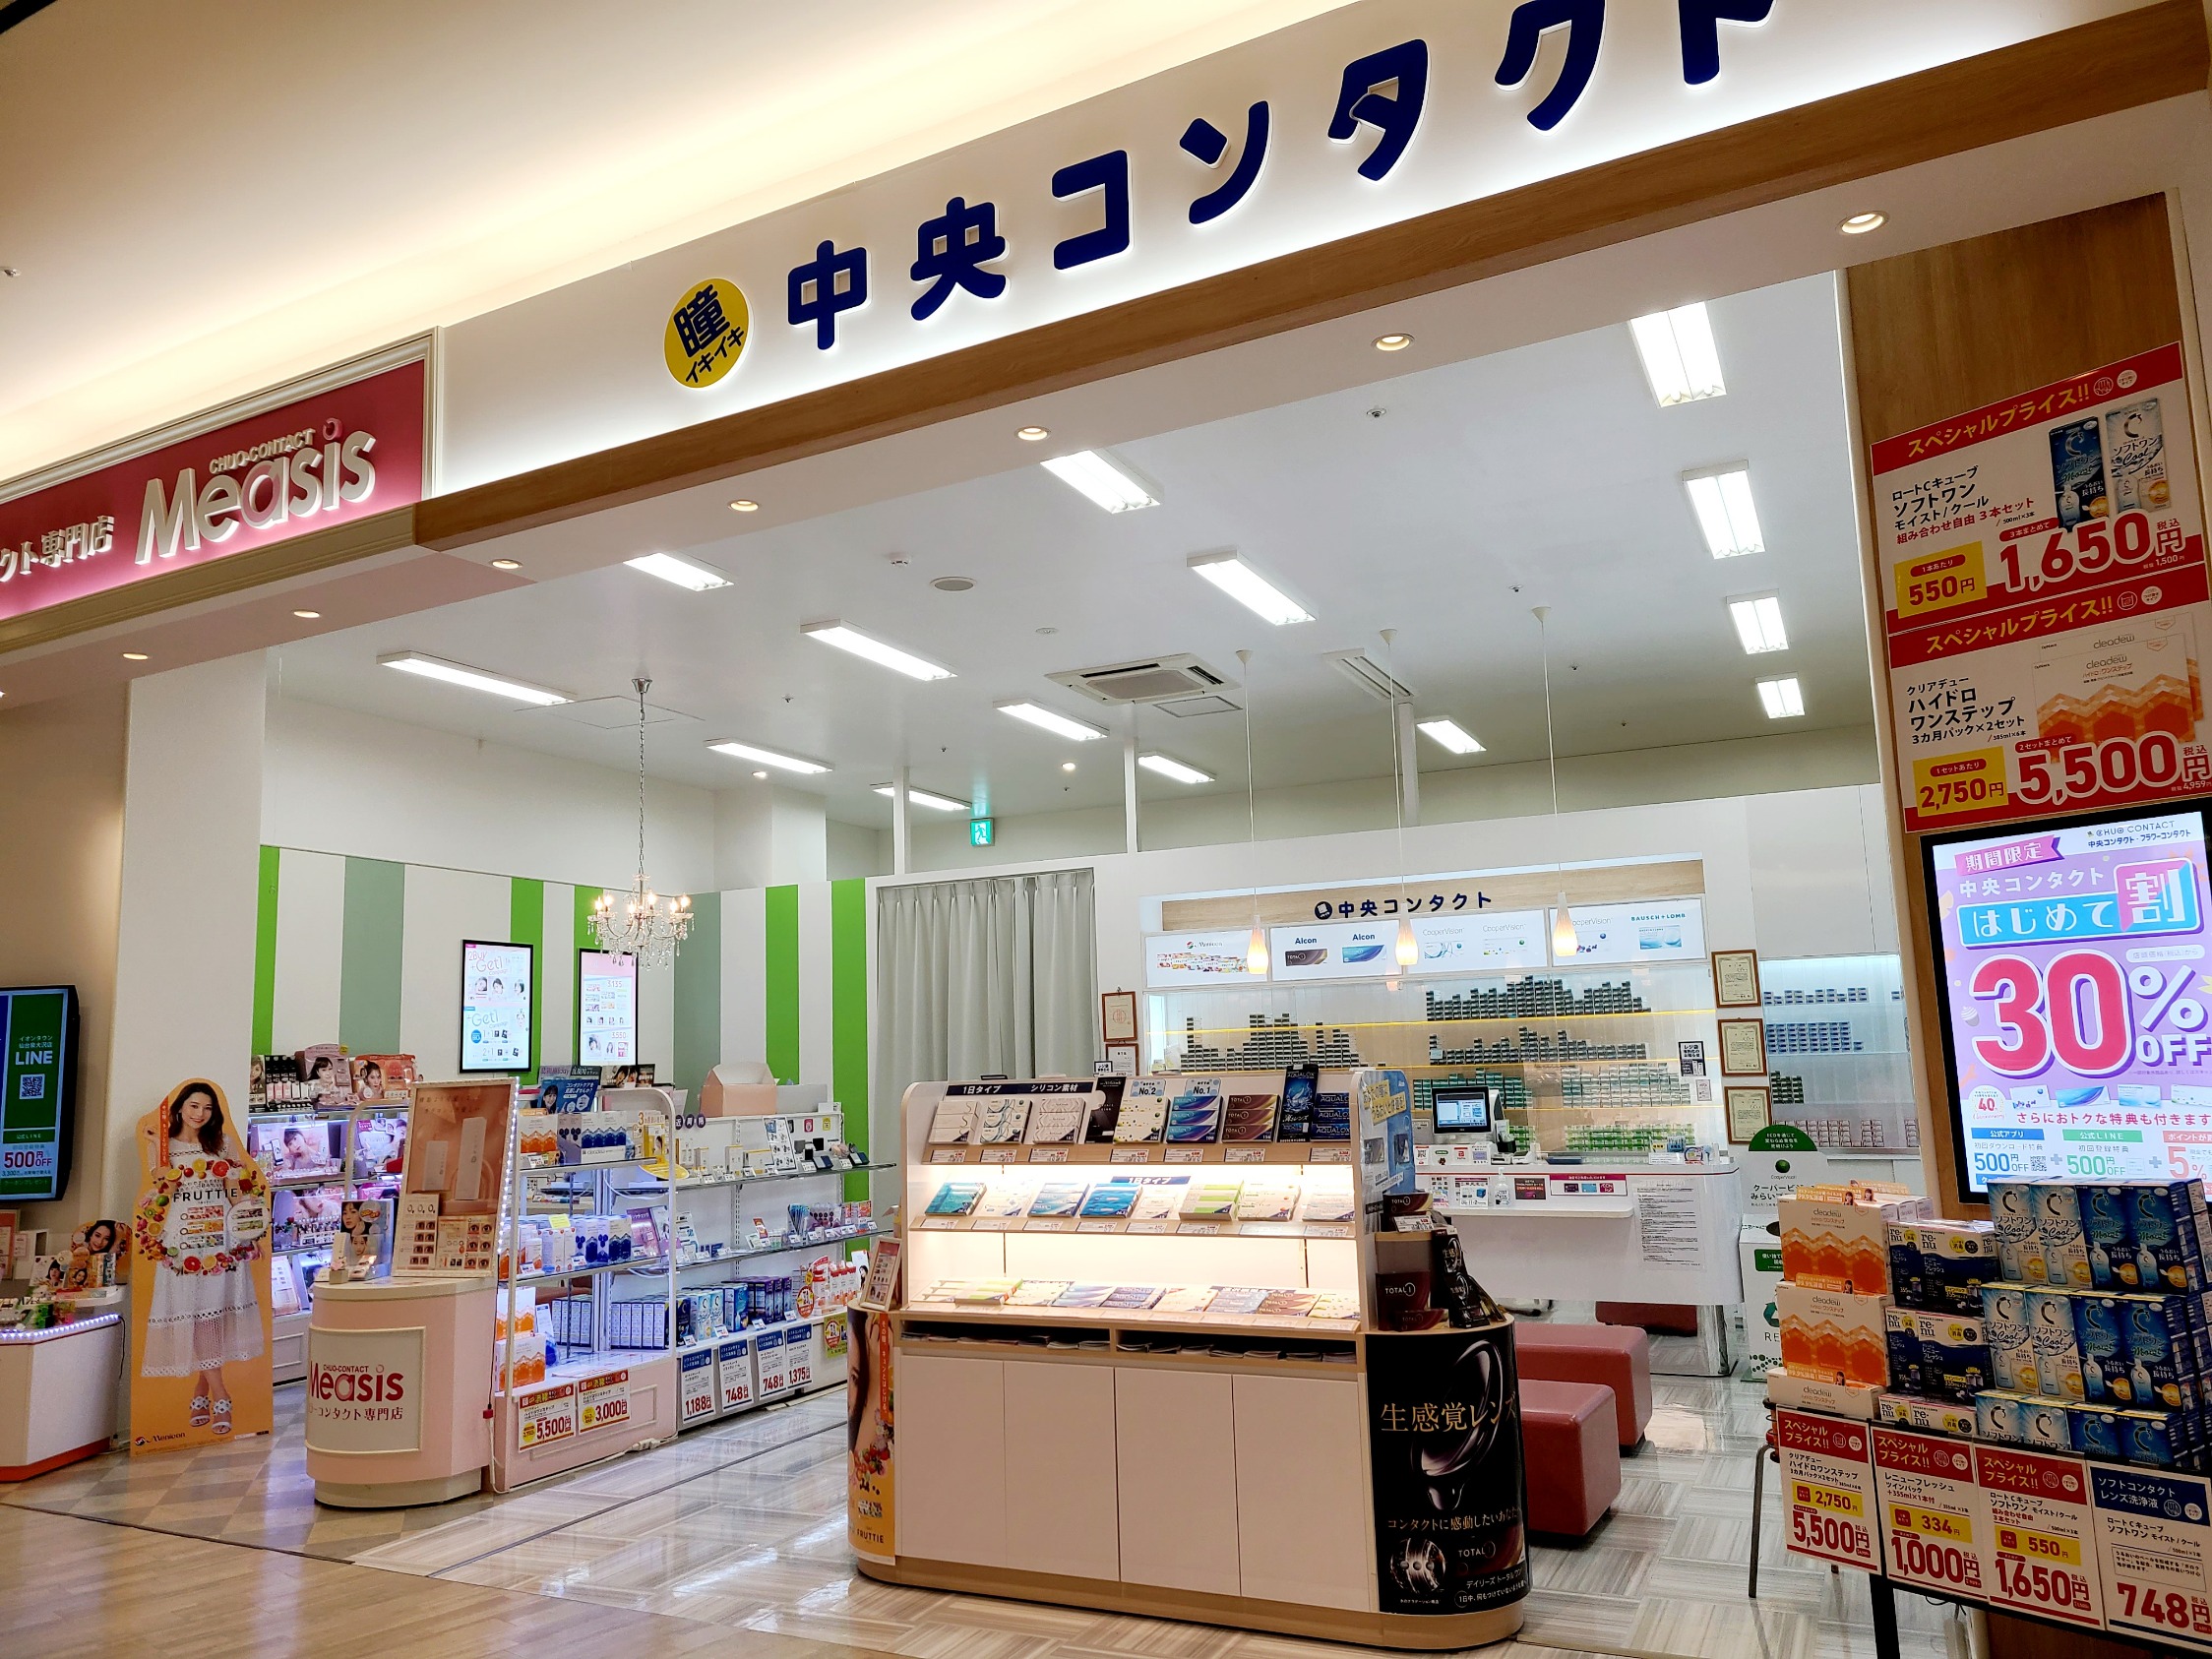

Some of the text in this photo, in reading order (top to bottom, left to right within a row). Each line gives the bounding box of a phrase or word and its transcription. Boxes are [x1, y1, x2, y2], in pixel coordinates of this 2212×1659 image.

[787, 0, 1771, 350] 中央コンタクト
[673, 283, 730, 358] 瞳
[685, 326, 745, 383] イキイキ
[135, 417, 377, 566] Measis
[1893, 483, 1976, 519] ソフトワン
[2093, 634, 2135, 649] cleadew
[2086, 654, 2127, 670] cleadew
[1906, 676, 1970, 697] クリアデュー
[1907, 687, 1977, 714] ハイドロ
[1909, 696, 2016, 733] ワンステップ
[2127, 821, 2176, 833] CONTACT
[1965, 841, 2044, 873] 期間限定
[1959, 866, 2104, 898] 中央コンタクト
[1482, 922, 1525, 934] CooperVision
[1571, 917, 1612, 928] ooperVision
[1423, 927, 1464, 938] CooperVision
[15, 1050, 53, 1066] LINE
[2135, 1033, 2210, 1067] OFF
[962, 1083, 1078, 1095] 1日タイプ シリコン素材
[1138, 1086, 1156, 1096] No.2
[1193, 1085, 1210, 1095] No.1
[173, 1188, 238, 1203] FRUTTIE
[310, 1361, 404, 1402] Measis
[1381, 1390, 1516, 1433] 生感覚レンズ
[1784, 1419, 1828, 1437] スペシャル
[1877, 1436, 1929, 1454] スペシャル
[1789, 1452, 1822, 1463] クリアデュー
[1984, 1456, 2037, 1475] スペシャル
[1789, 1460, 1859, 1480] ハイドロワンステップ
[1884, 1471, 1955, 1493] レニューフレッシュ
[1885, 1481, 1923, 1494] ツインパック
[2098, 1477, 2176, 1498] ソフトコンタクト
[1990, 1499, 2028, 1512] ソフトワン
[2101, 1490, 2159, 1509] レンズ洗浄液
[856, 1527, 885, 1544] FRUTTIE
[2108, 1525, 2149, 1539] ソフトワン
